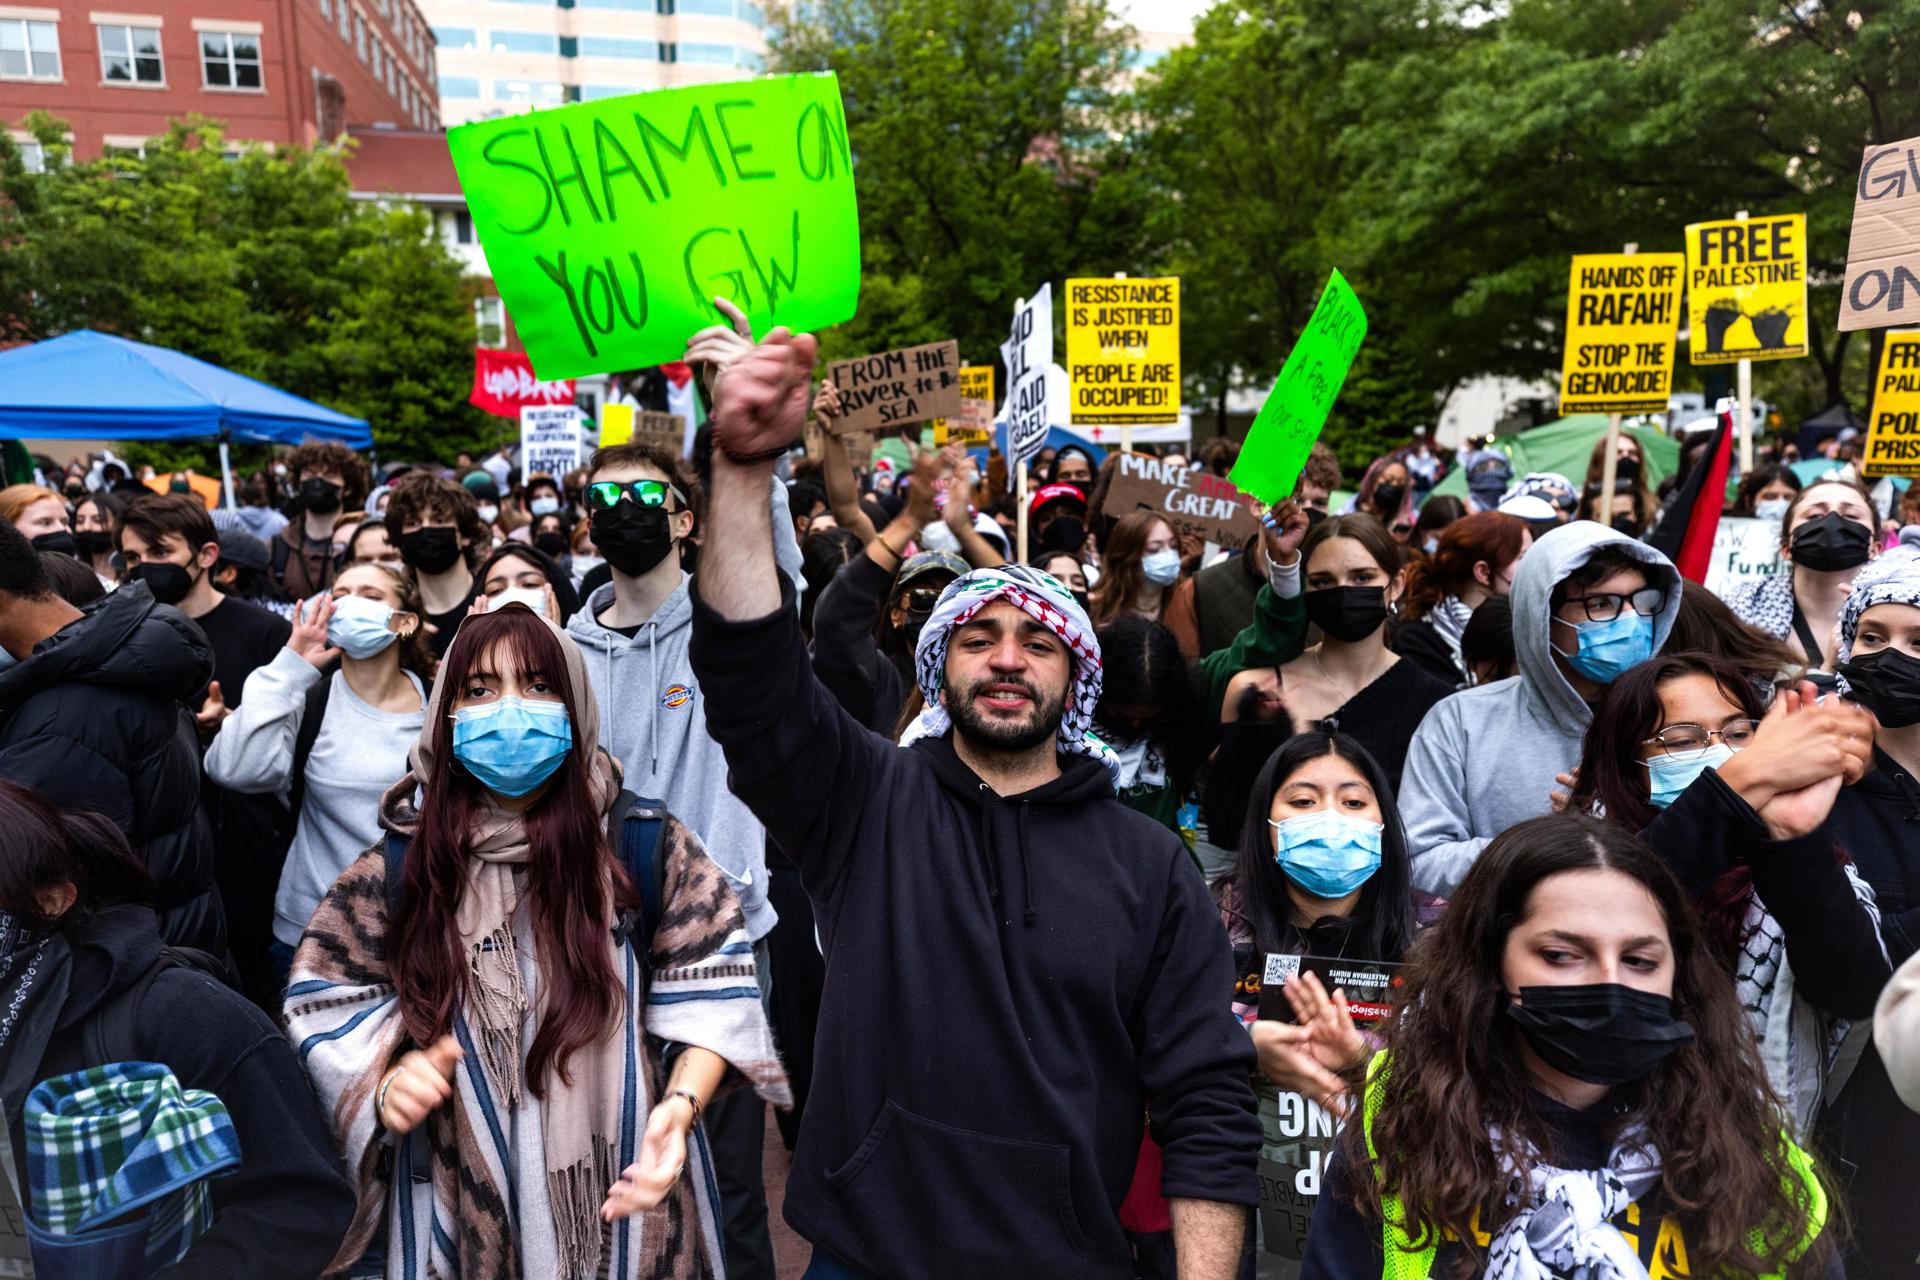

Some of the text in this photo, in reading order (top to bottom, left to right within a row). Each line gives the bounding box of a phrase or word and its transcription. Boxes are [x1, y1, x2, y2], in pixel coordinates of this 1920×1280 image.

[482, 99, 851, 236] SHAME ON
[1700, 219, 1795, 267] FREE
[533, 209, 800, 359] YOU GW
[1580, 264, 1678, 290] HANDS OFF
[1693, 261, 1801, 290] PALESTINE
[1072, 284, 1173, 304] RESISTANCE
[1073, 307, 1173, 327] IS JUSTIFIED
[1577, 292, 1674, 327] RAFAH!
[1098, 330, 1148, 348] WHEN
[1577, 343, 1630, 368] STOP
[1635, 342, 1667, 366] THE
[832, 350, 907, 389] FROM
[1072, 363, 1174, 383] PEOPLE ARE
[1567, 370, 1668, 396] GENOCIDE!
[1019, 373, 1046, 417] AID
[1079, 387, 1169, 407] OCCUPIED!
[878, 397, 920, 424] SEA
[1120, 452, 1191, 489] MAKE
[1164, 488, 1242, 521] GREAT
